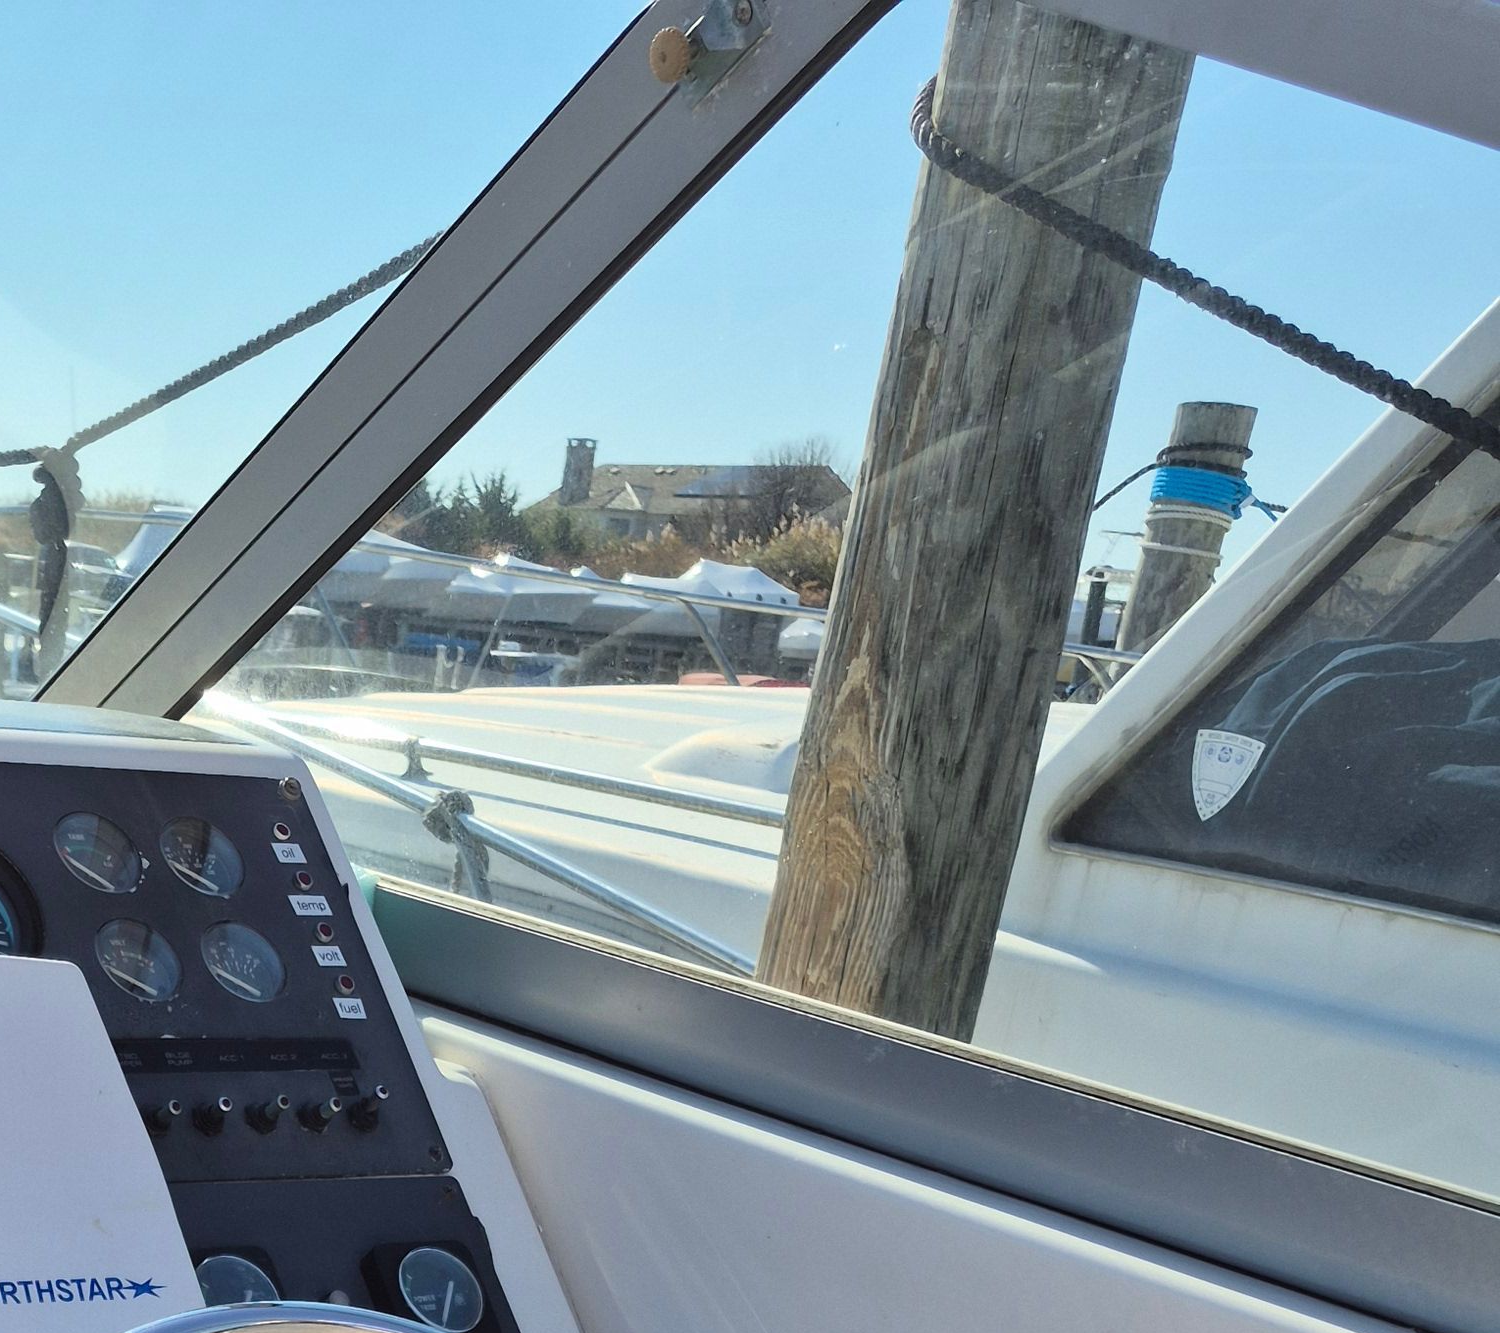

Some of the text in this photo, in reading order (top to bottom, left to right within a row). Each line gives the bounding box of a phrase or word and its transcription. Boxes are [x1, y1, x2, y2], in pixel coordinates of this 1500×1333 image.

[281, 848, 295, 859] oil
[297, 900, 327, 912] temp
[319, 950, 341, 962] volt
[338, 1002, 362, 1014] fuel
